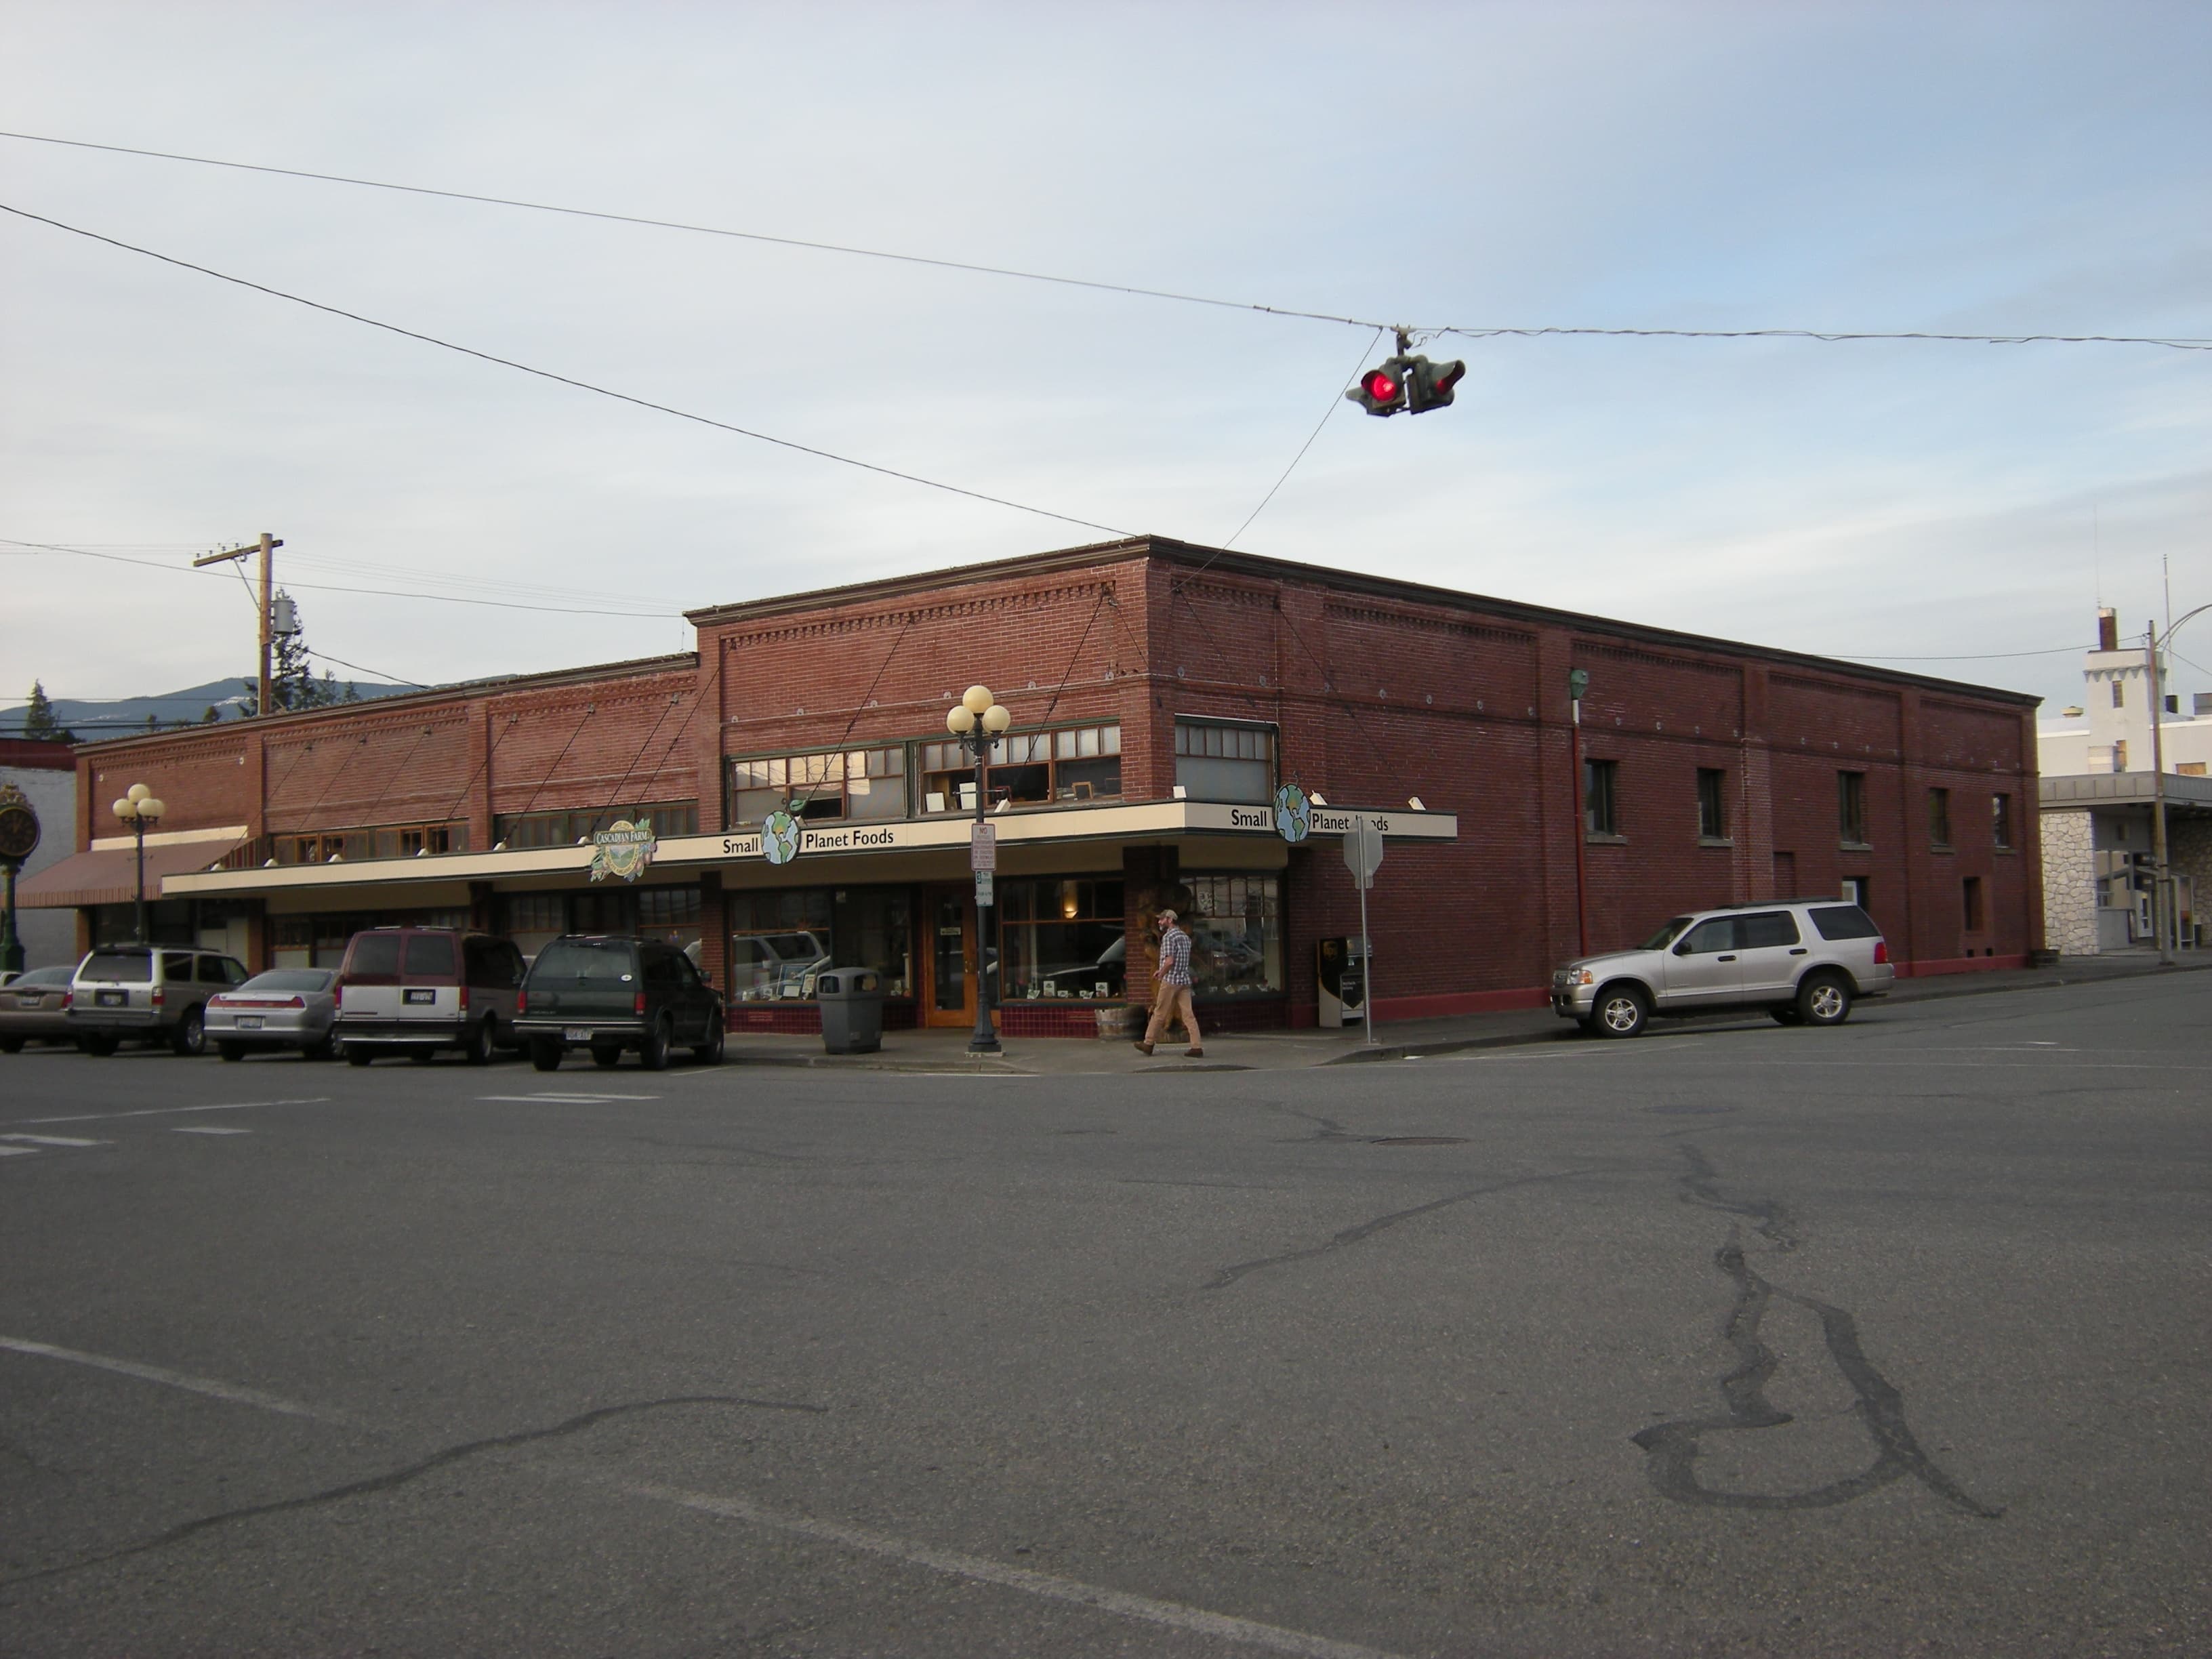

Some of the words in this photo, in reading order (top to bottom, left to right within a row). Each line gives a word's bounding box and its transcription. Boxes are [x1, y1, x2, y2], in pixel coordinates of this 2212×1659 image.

[1231, 809, 1267, 827] Small
[1312, 813, 1349, 830] Planet
[597, 833, 630, 844] CASCADIAN
[630, 831, 647, 842] FARM
[722, 838, 758, 854] Small
[806, 833, 848, 849] Planet
[853, 828, 894, 845] Foods
